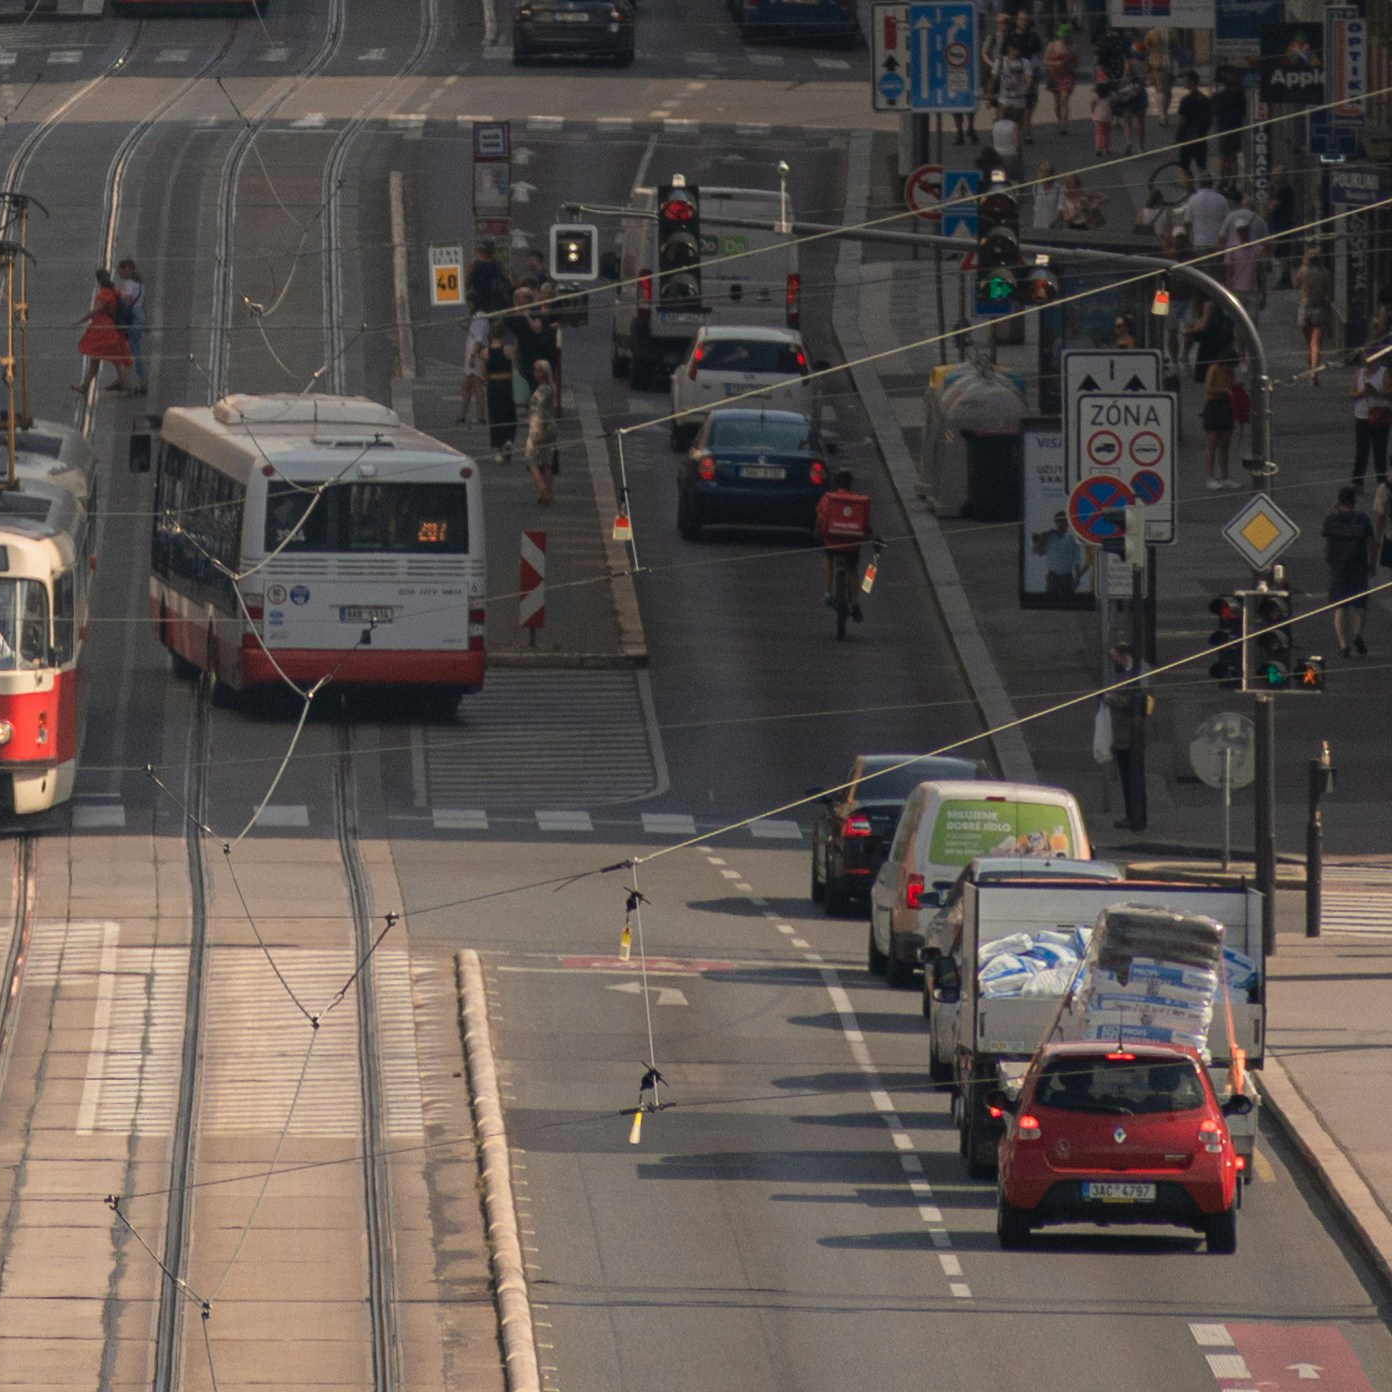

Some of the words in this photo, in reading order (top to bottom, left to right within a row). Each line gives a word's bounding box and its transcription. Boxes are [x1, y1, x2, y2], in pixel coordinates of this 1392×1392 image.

[437, 273, 458, 291] 40
[1089, 400, 1163, 427] ZÓNA
[947, 810, 998, 820] MILUJEME
[1092, 1185, 1113, 1196] 3AC
[1122, 1186, 1150, 1196] 4797
